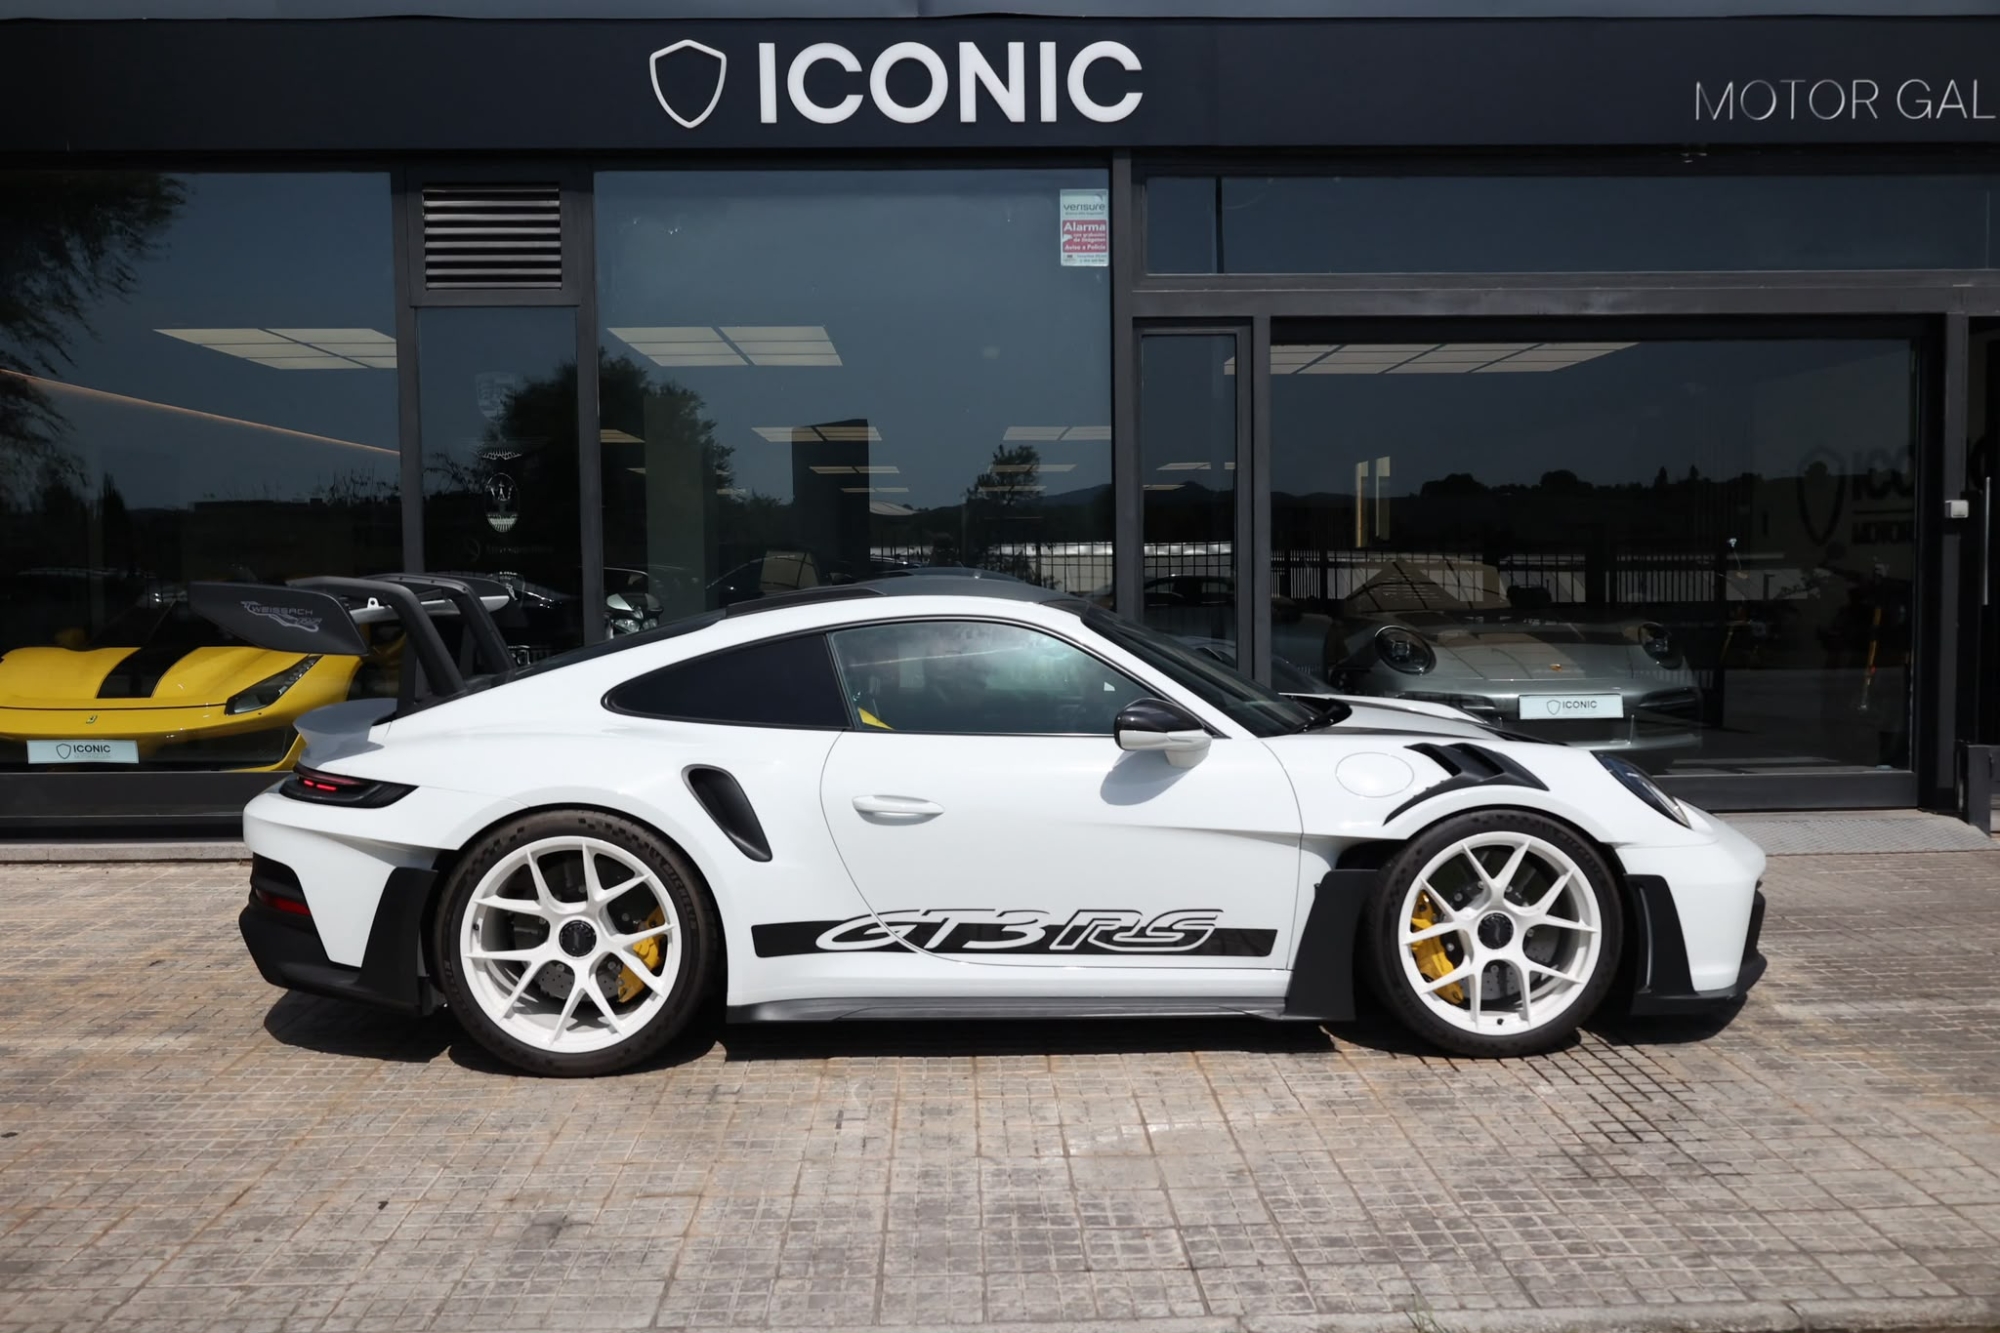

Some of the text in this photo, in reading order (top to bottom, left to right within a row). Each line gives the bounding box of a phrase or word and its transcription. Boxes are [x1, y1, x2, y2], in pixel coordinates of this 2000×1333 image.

[758, 40, 1143, 124] ICONIC
[1695, 79, 1997, 120] MOTOR GAL
[1063, 203, 1106, 211] verisure
[1063, 222, 1106, 232] Alarma
[251, 605, 314, 616] WEISSACH
[1562, 700, 1598, 709] ICONIC
[73, 744, 111, 753] ICONIC
